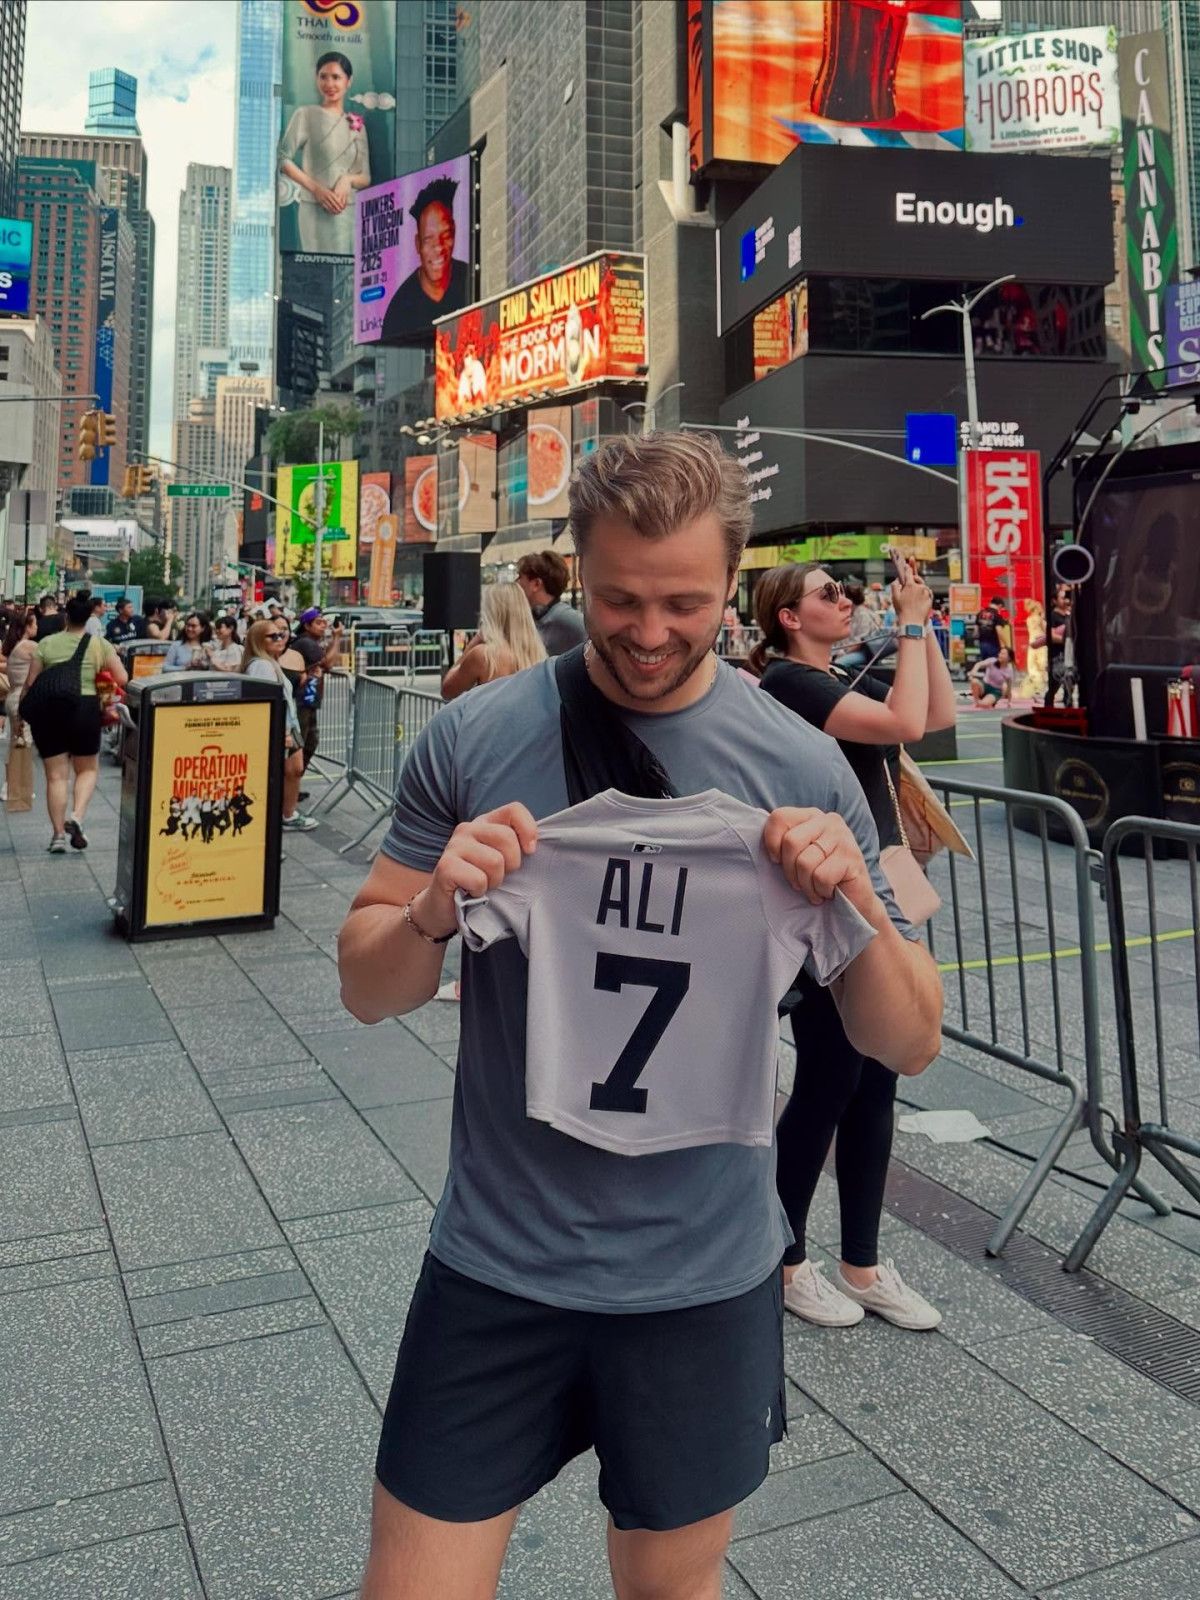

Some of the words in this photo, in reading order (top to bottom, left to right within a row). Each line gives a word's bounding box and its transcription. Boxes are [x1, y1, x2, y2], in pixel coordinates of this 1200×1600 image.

[297, 17, 328, 28] THAI
[297, 32, 332, 41] Smooth
[978, 38, 1046, 78] LITTLE
[1052, 38, 1103, 66] SHOP
[978, 72, 1104, 132] HORRORS
[361, 192, 395, 218] LINKERS
[896, 193, 1024, 232] Enough.
[1134, 48, 1165, 373] CANNABIS
[361, 217, 371, 236] AT
[372, 208, 403, 234] VIDCON
[361, 229, 400, 254] ANAHEIM
[361, 252, 382, 273] 2025
[500, 292, 528, 331] FIND
[530, 260, 599, 318] SALVATION
[501, 334, 519, 352] THE
[520, 326, 548, 347] BOOK
[550, 320, 566, 337] OF
[961, 421, 1000, 434] SAND
[1001, 422, 1019, 434] UP
[979, 434, 1024, 447] JEWISH
[182, 487, 191, 495] W
[194, 487, 204, 495] 47
[985, 457, 1030, 554] tkts
[173, 754, 248, 780] OPERATION
[596, 857, 688, 936] ALI
[589, 951, 691, 1114] 7
